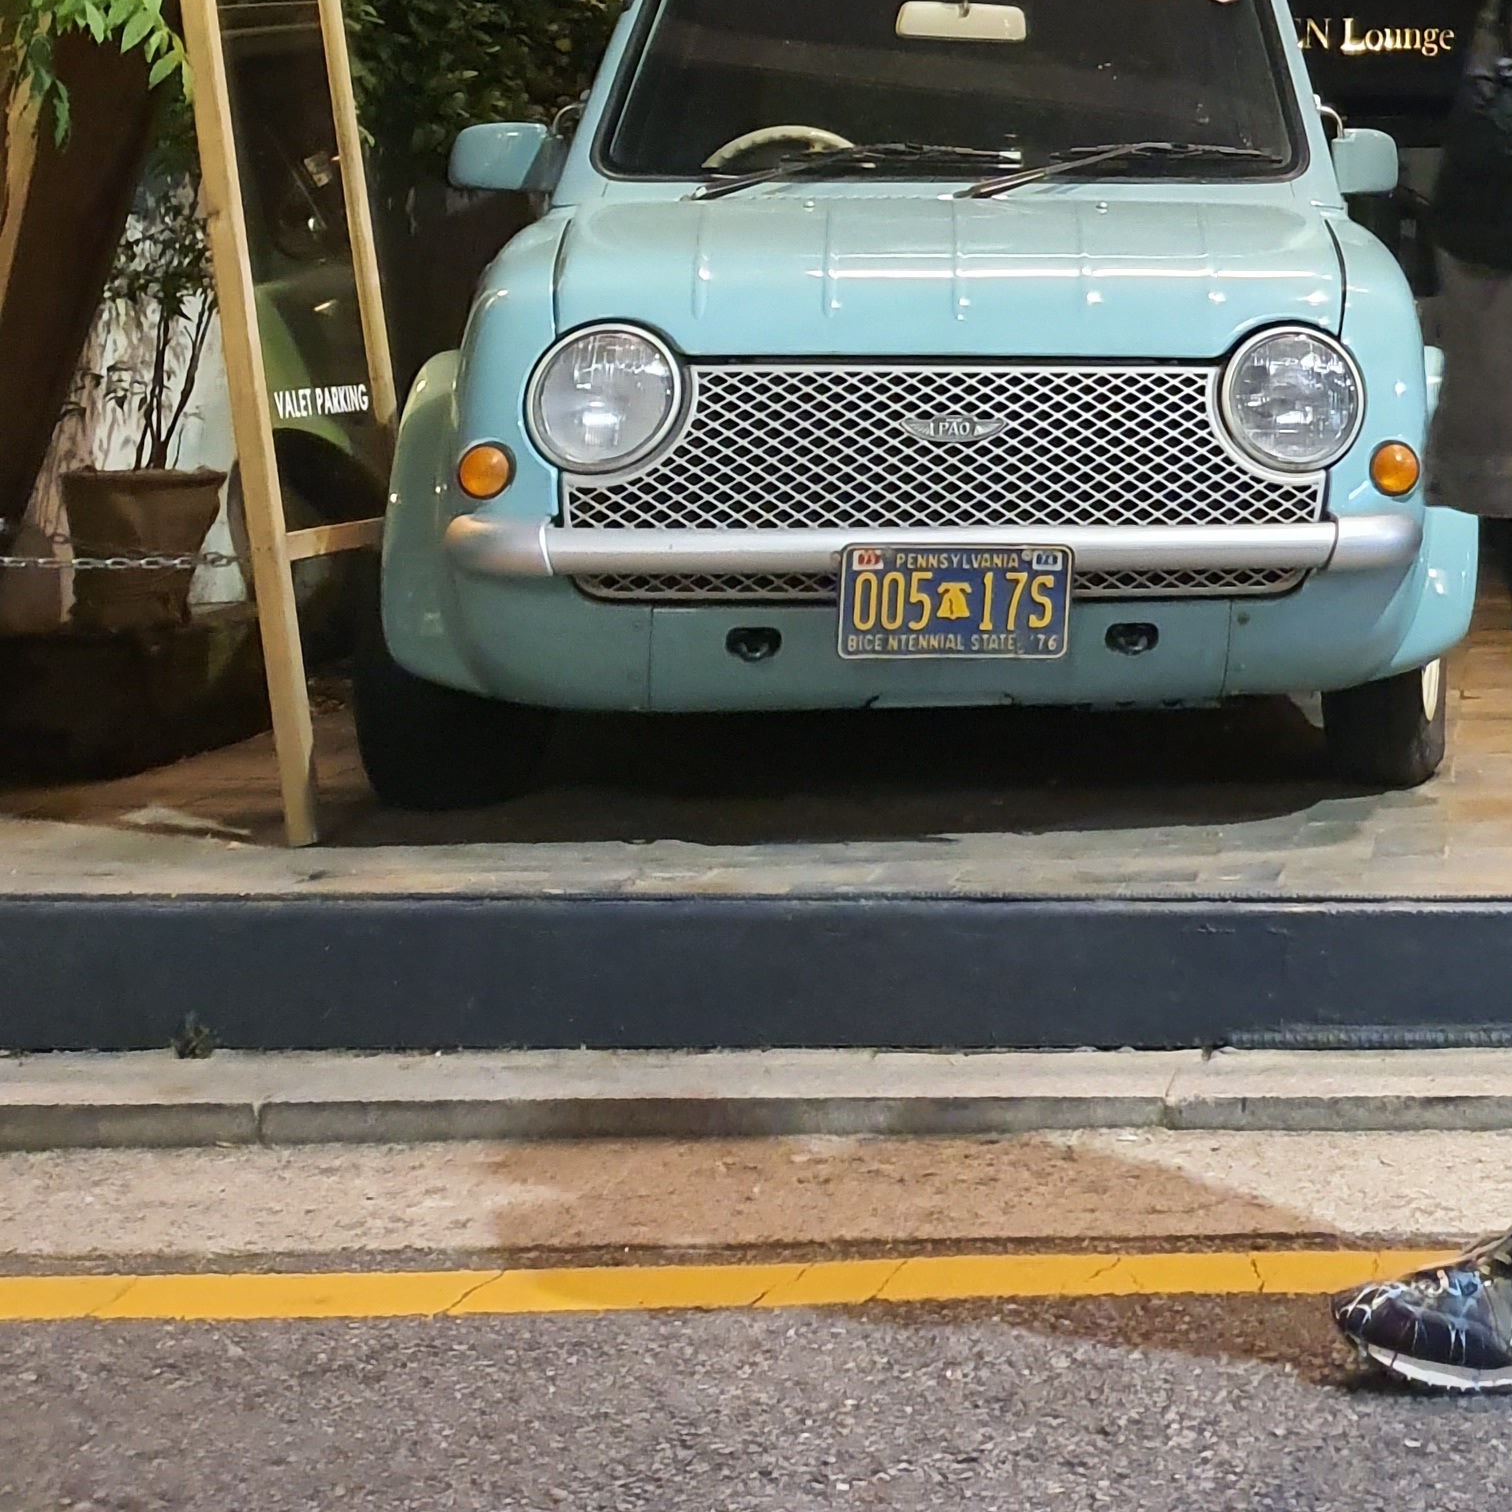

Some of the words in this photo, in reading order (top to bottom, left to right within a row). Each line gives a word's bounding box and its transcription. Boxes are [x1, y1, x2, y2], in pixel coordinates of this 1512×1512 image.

[1340, 18, 1455, 56] Lounge
[274, 388, 312, 419] VALET
[315, 384, 369, 415] PARKING
[939, 421, 970, 436] PAO
[896, 552, 1019, 569] PENNSYLVANIA
[853, 571, 933, 631] 005
[979, 571, 1055, 631] 17S
[971, 634, 1016, 650] STATE
